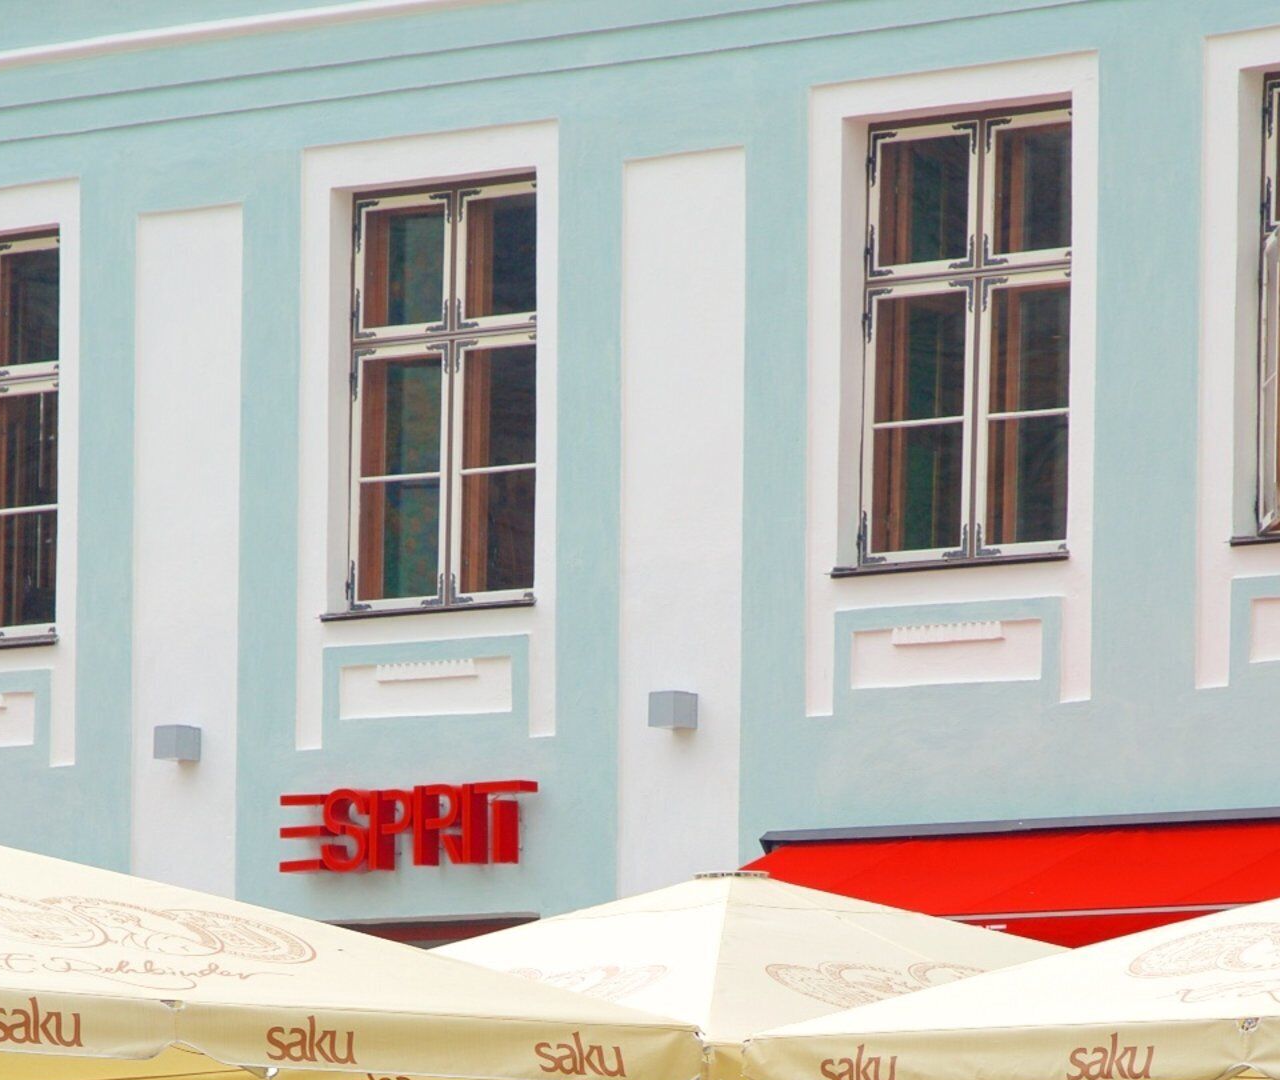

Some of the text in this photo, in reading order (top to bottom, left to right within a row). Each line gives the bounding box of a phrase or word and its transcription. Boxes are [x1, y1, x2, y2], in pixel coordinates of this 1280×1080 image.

[279, 780, 538, 873] ESPRIT
[266, 1015, 357, 1065] saku
[535, 1031, 626, 1077] saku
[1067, 1032, 1154, 1080] saku
